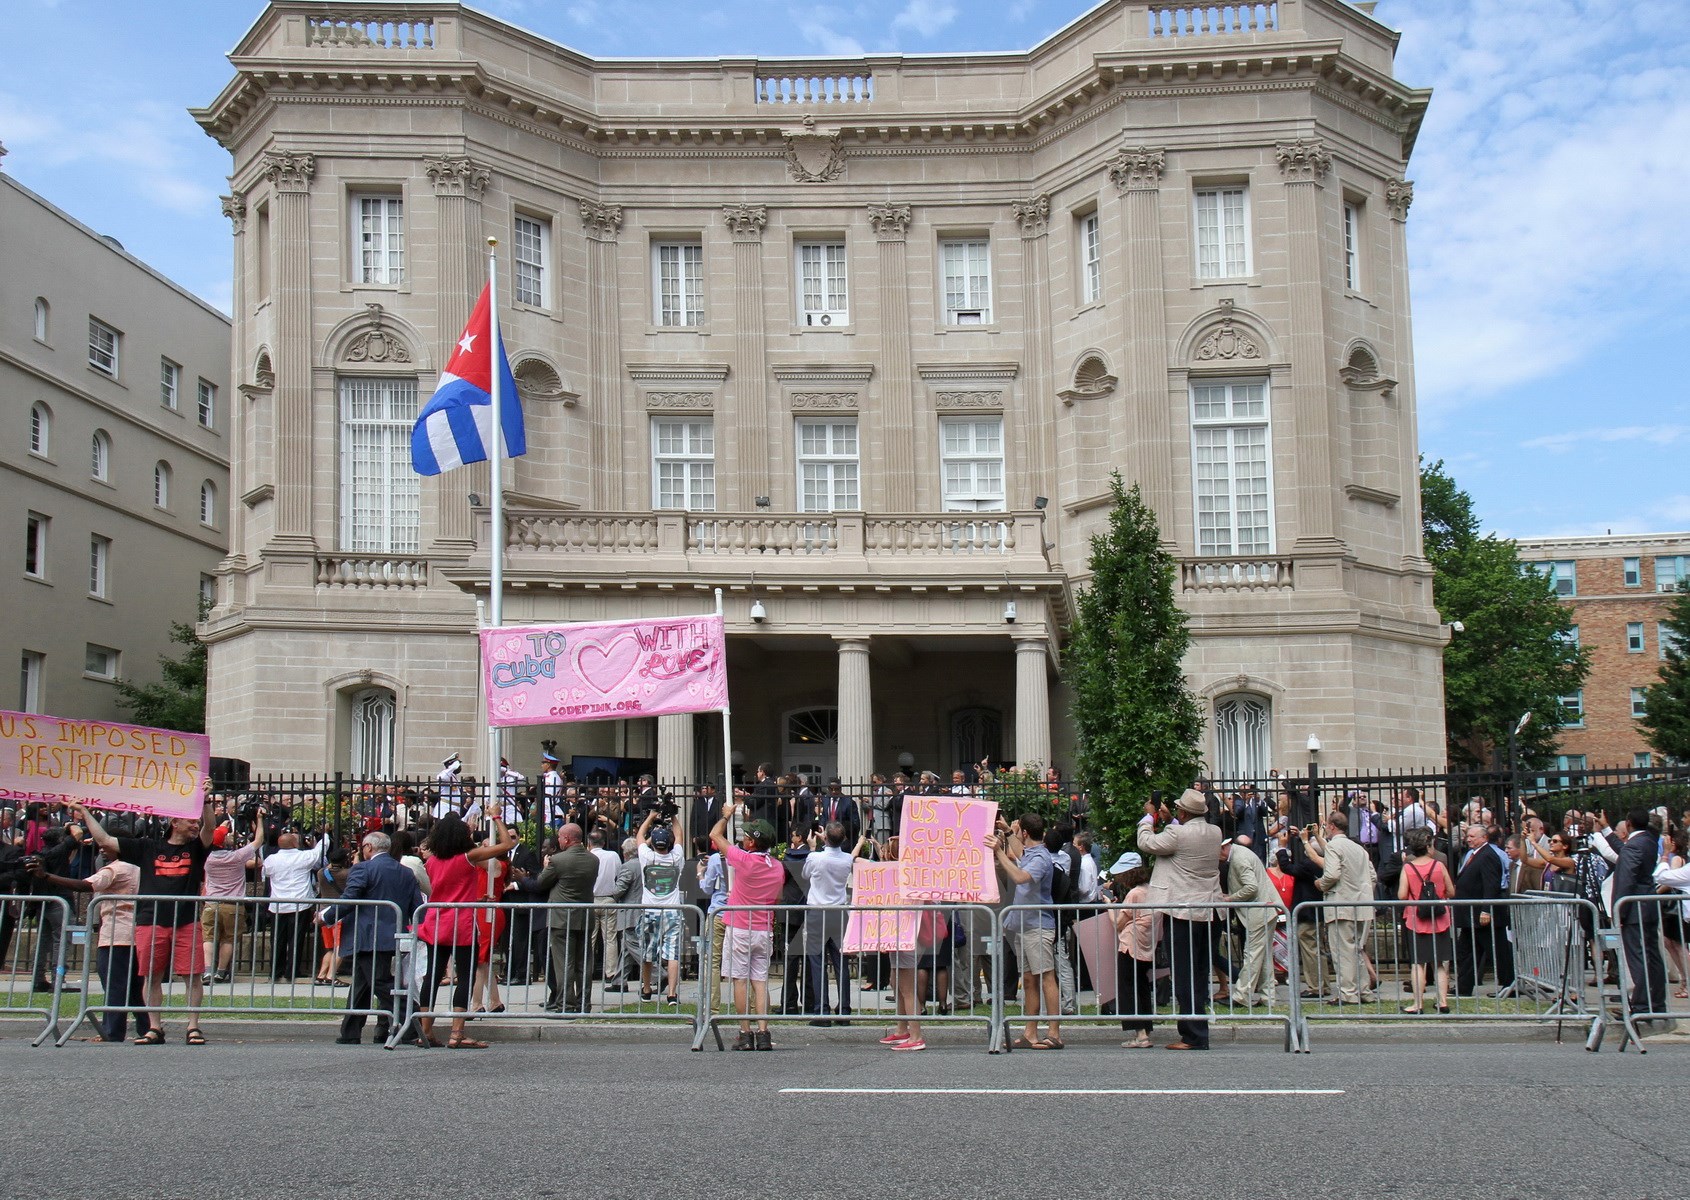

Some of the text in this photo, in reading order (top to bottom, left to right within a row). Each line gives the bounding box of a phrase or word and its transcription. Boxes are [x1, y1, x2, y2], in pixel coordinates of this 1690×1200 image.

[526, 631, 567, 658] TO
[633, 623, 710, 652] WITH
[639, 646, 722, 682] LOVE!
[550, 700, 643, 717] CODEPINK.ORG
[58, 721, 187, 757] IMPOSED
[20, 744, 198, 797] RESTRICTIONS
[910, 800, 972, 828] U.S. Y
[911, 827, 973, 848] CUBA
[901, 846, 983, 868] AMISTAD
[857, 867, 887, 892] LIFT
[902, 867, 981, 891] SIEMPRE
[906, 891, 983, 902] CODEPINK
